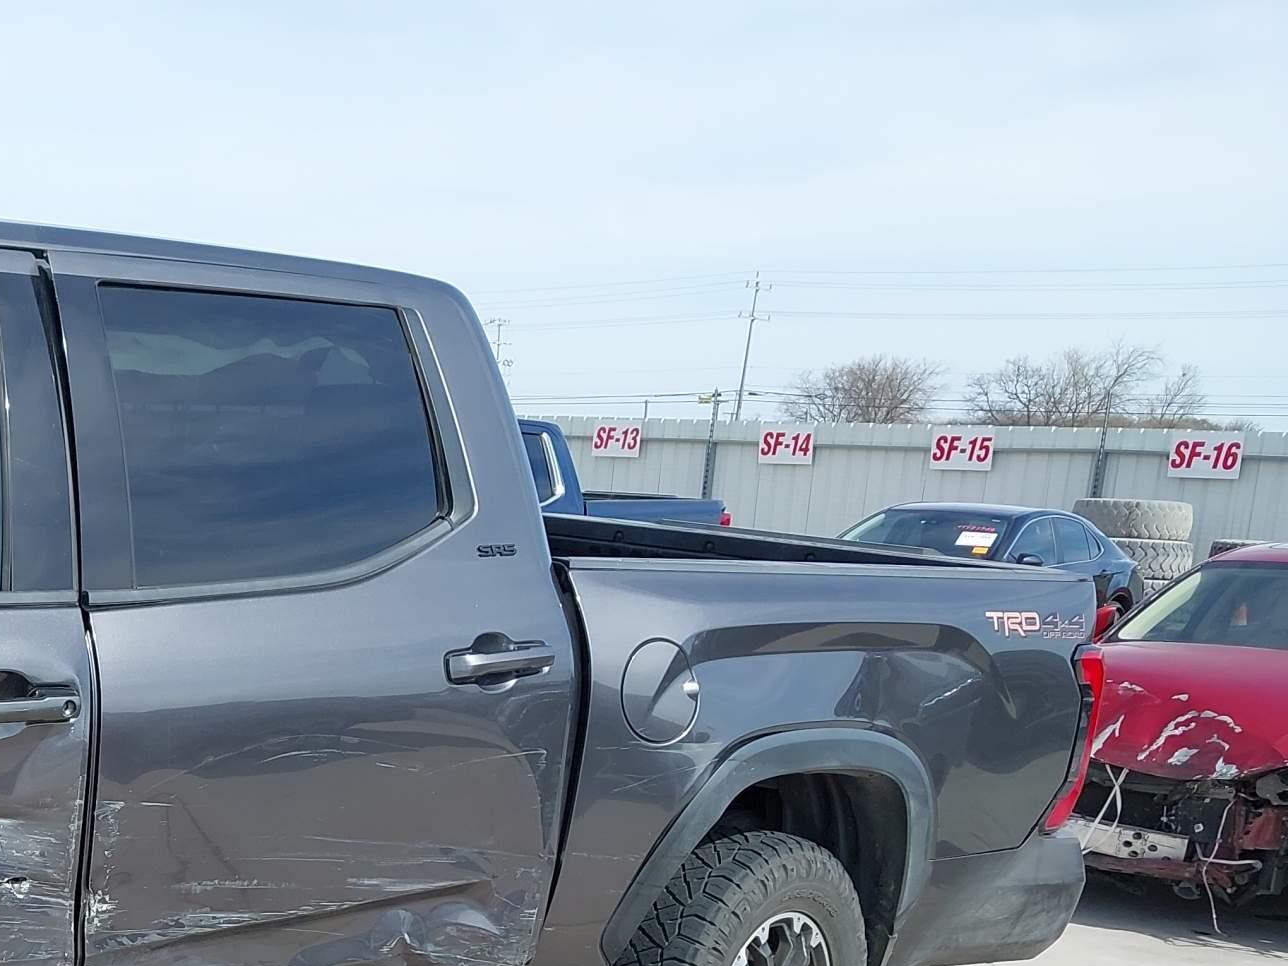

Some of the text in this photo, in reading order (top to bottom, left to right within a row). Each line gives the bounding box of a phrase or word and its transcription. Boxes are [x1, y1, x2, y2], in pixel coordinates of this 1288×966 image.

[594, 426, 640, 450] SF-13
[760, 431, 812, 457] SF-14
[932, 435, 993, 464] SF-15
[1170, 441, 1241, 470] SF-16
[477, 544, 517, 558] SR5
[985, 611, 1041, 637] TRD
